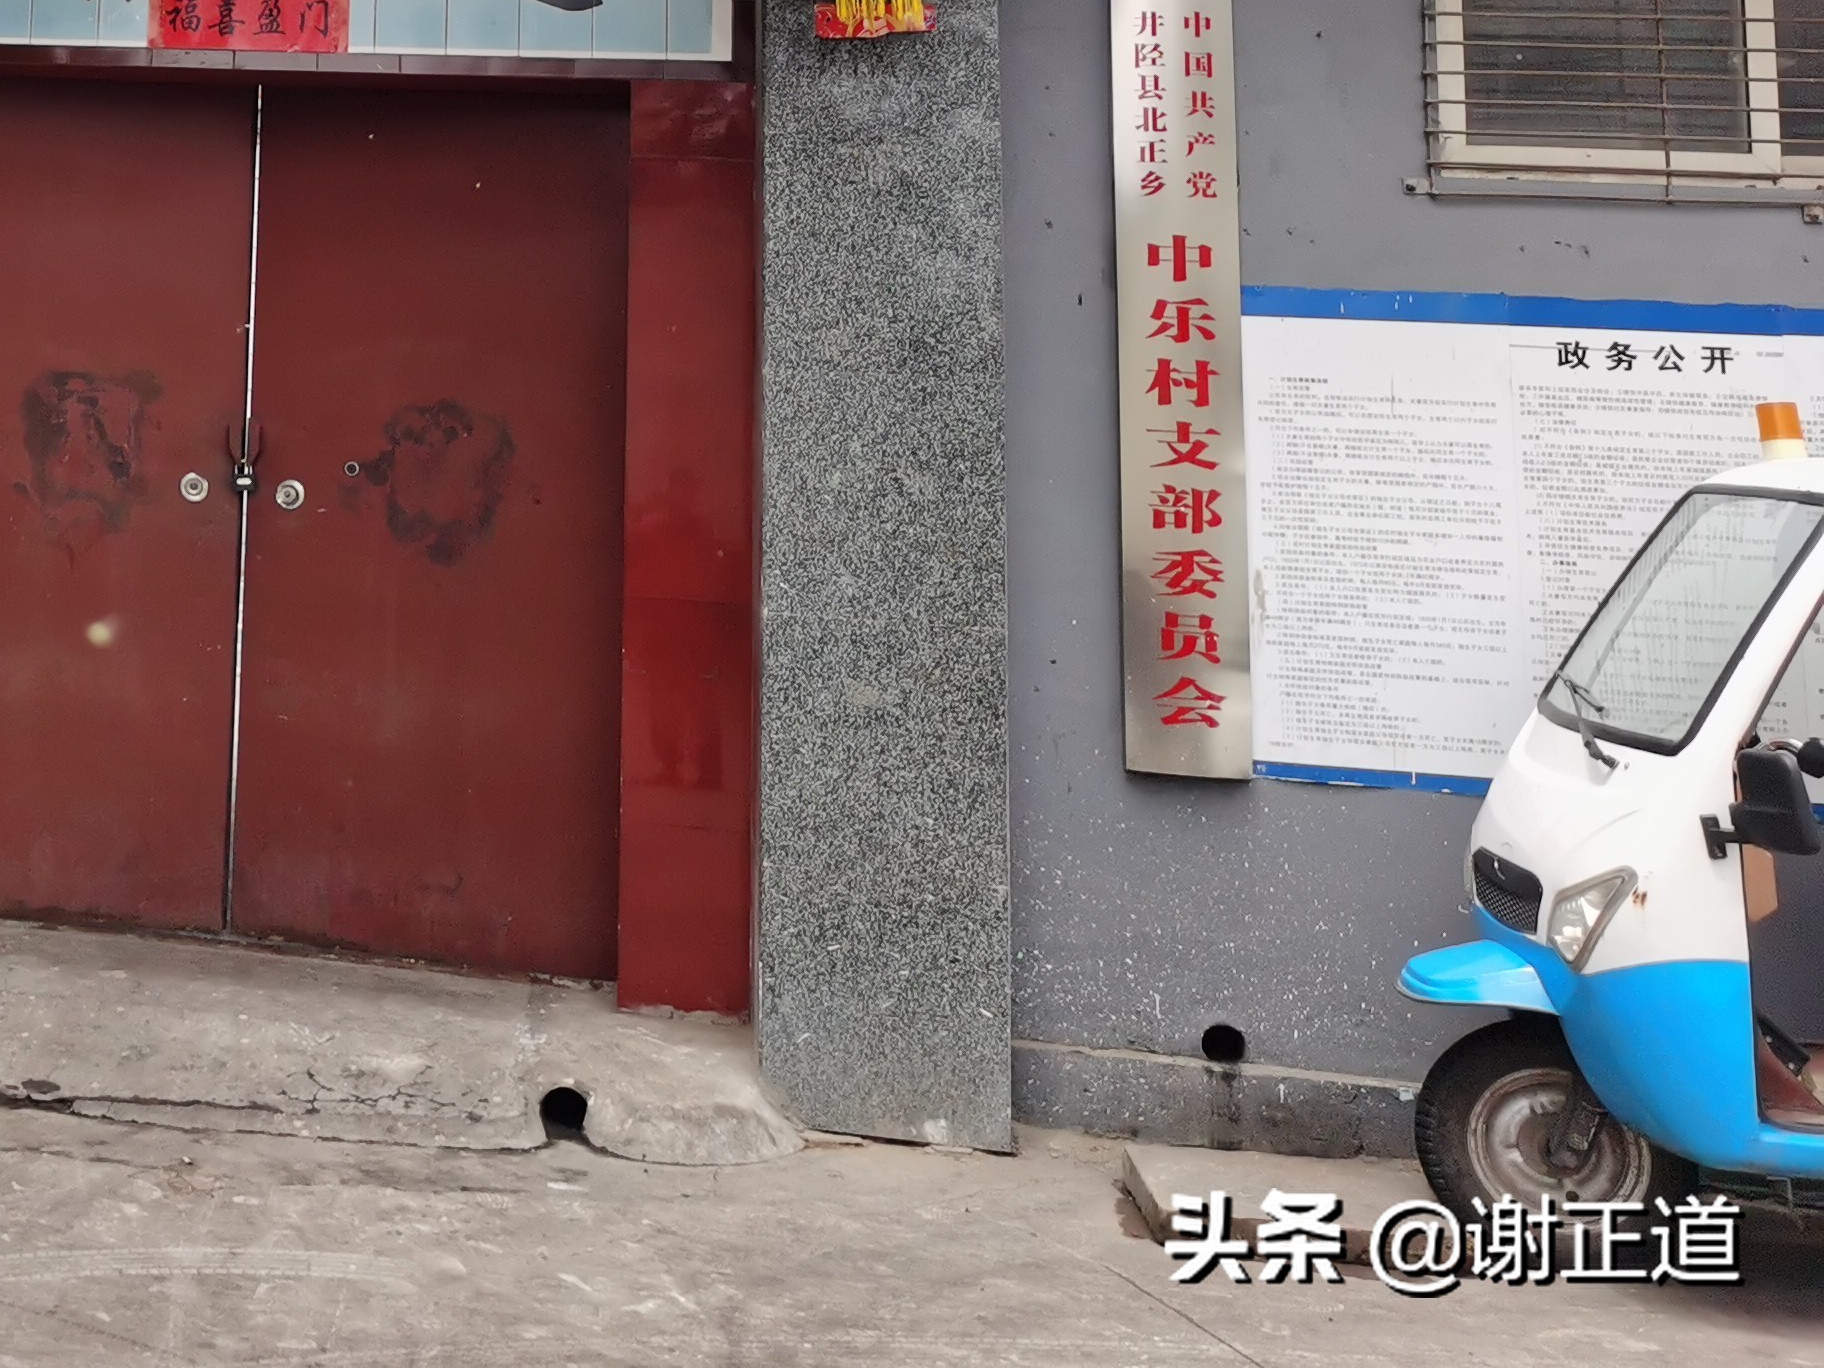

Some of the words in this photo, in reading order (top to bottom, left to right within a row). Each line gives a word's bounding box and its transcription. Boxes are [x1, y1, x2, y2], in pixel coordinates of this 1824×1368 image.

[1133, 11, 1168, 197] 井陉县北正乡
[1183, 11, 1218, 198] 中国共产党
[1556, 340, 1734, 374] 政务公开
[1144, 234, 1228, 728] 中乐村支部委员会
